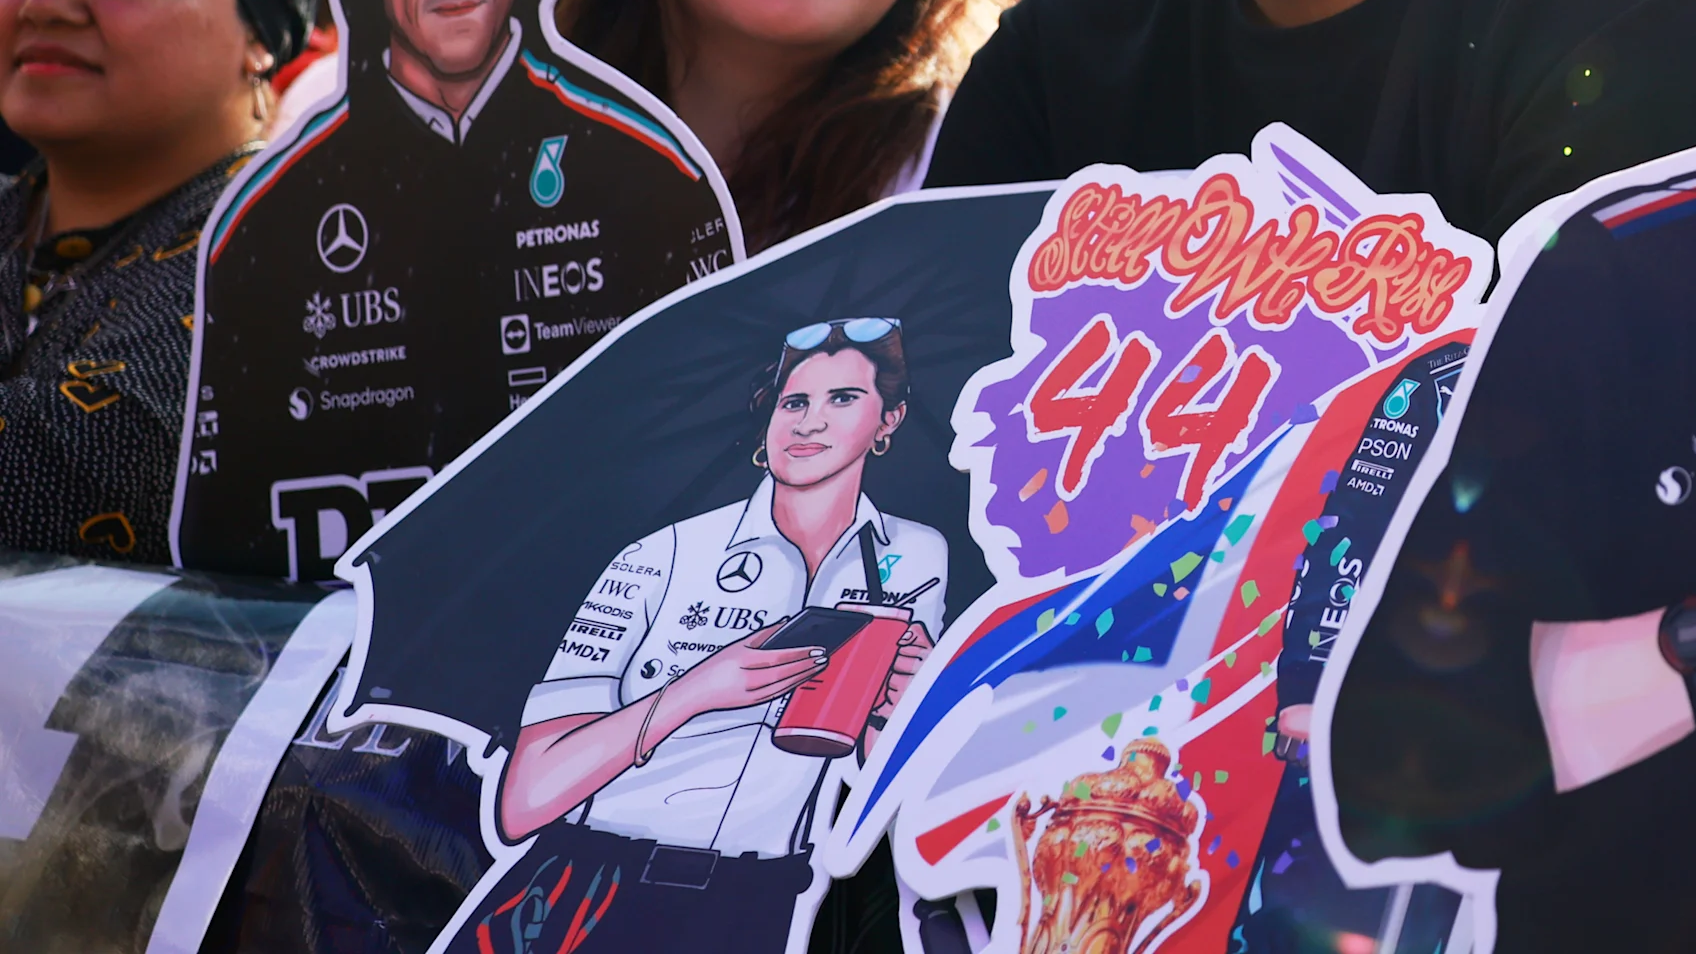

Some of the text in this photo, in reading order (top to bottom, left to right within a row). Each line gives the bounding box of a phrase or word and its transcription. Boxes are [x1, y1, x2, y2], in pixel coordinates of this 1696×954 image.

[515, 219, 600, 249] PETRONAS
[1028, 182, 1186, 292] Still
[1307, 214, 1472, 341] Rise
[513, 257, 604, 302] INEOS
[341, 287, 402, 328] UBS
[310, 346, 407, 371] CROWDSTRIKE
[320, 386, 414, 412] Snapdragon
[1028, 321, 1274, 513] 44
[1370, 418, 1419, 438] TRONAS
[1358, 437, 1412, 460] PSON
[1351, 459, 1395, 480] PIRELLI
[1347, 477, 1375, 493] AMD
[610, 561, 661, 577] SOLERA
[598, 579, 640, 600] IWC
[714, 606, 768, 631] UBS
[1308, 557, 1362, 661] INEOS
[570, 617, 627, 641] IRELLI
[559, 639, 595, 659] AMD
